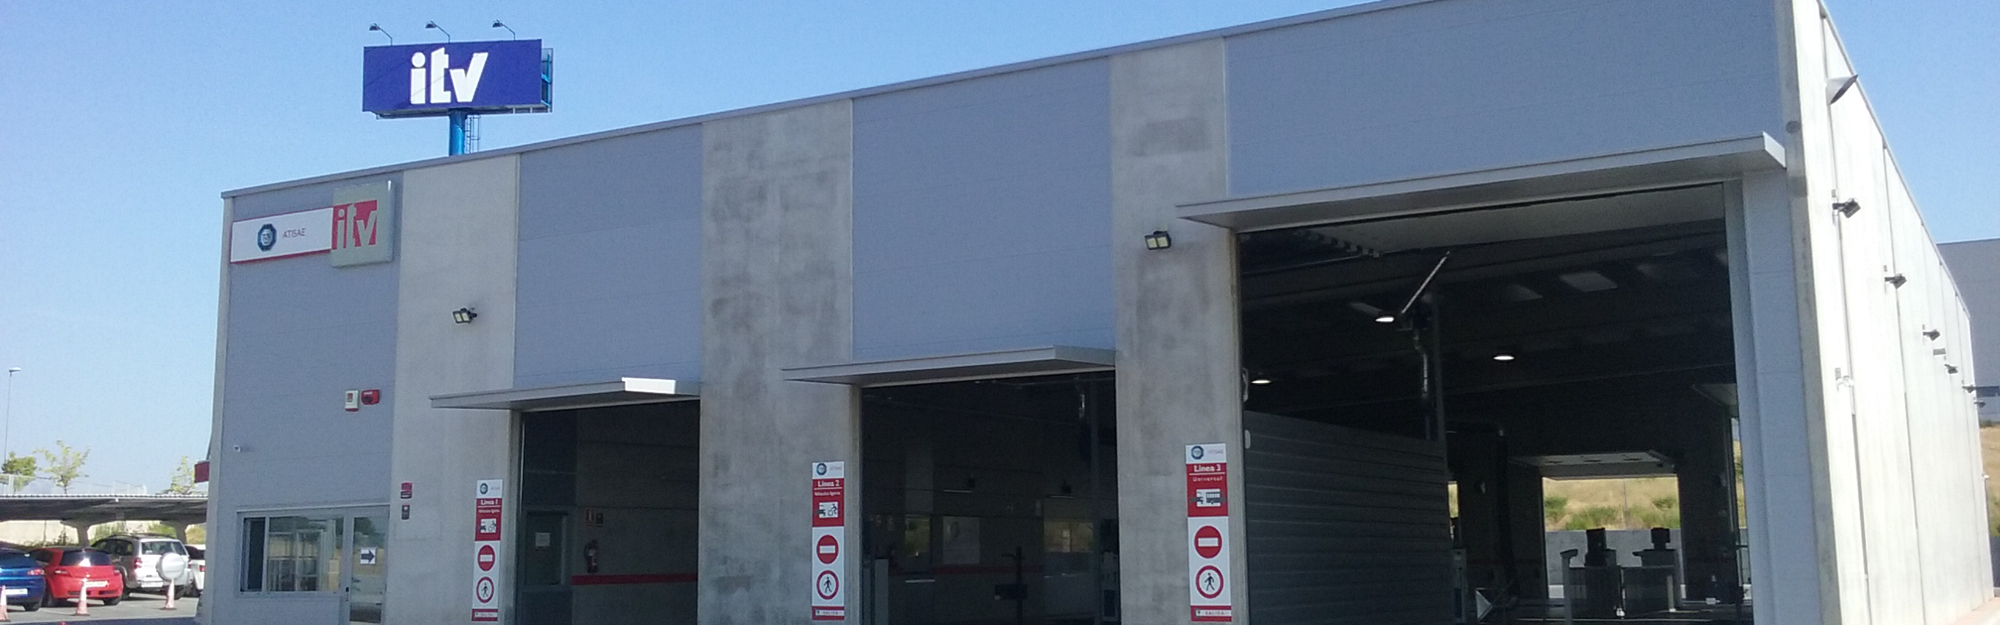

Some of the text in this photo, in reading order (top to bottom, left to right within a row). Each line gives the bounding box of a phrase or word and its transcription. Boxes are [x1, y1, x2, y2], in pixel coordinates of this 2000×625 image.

[410, 47, 489, 105] itv
[283, 227, 306, 238] ATISAE
[337, 203, 378, 250] itv
[1216, 463, 1221, 472] 3
